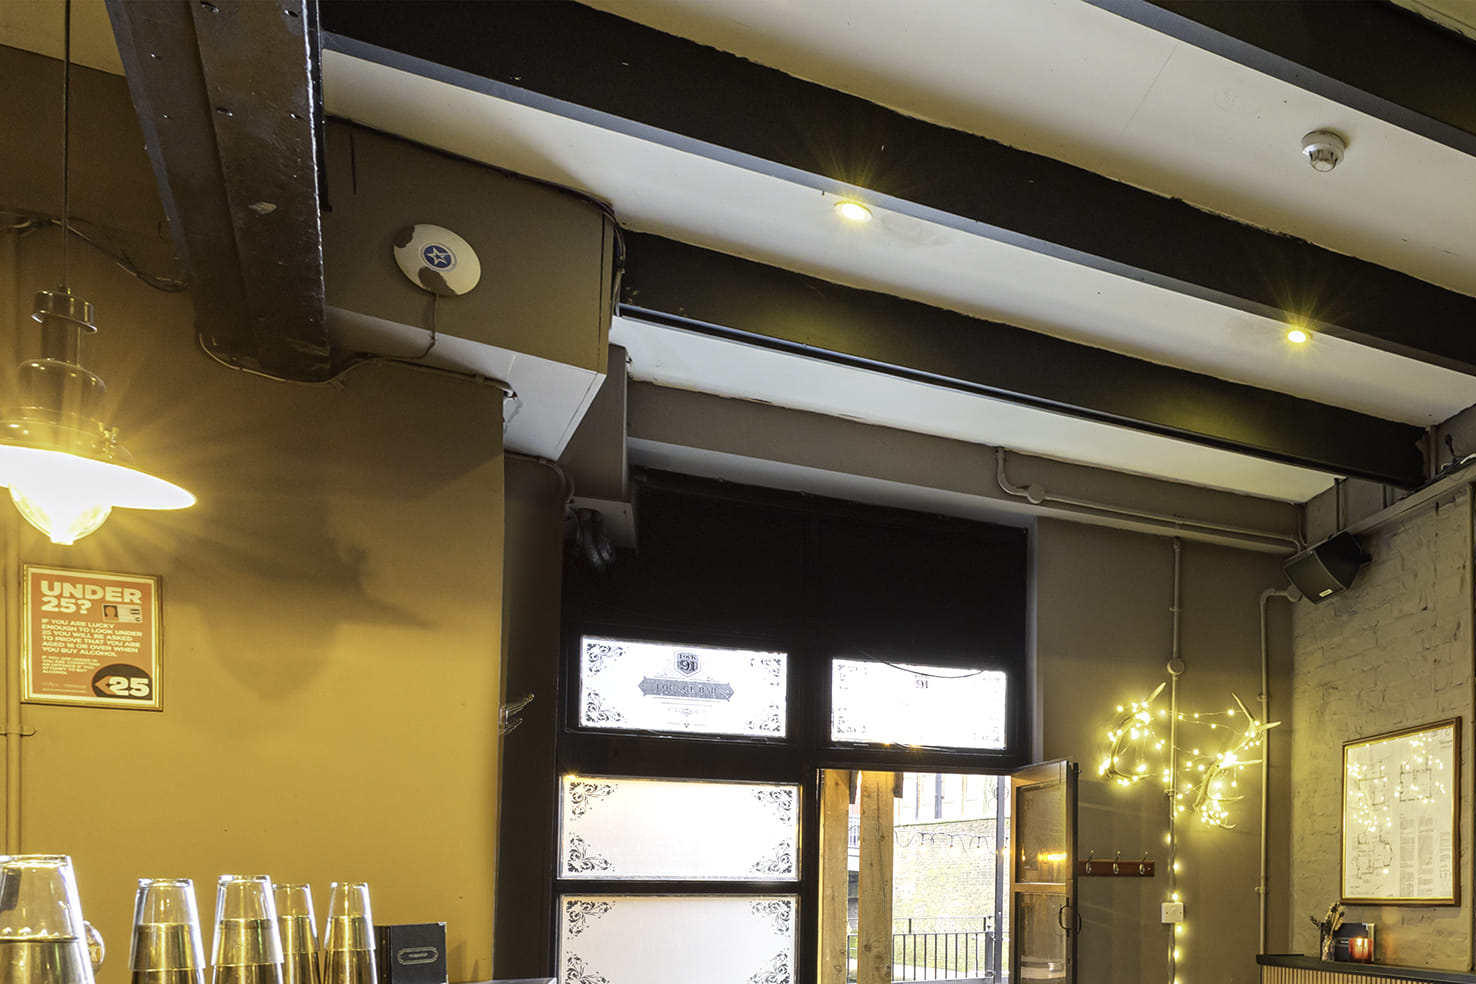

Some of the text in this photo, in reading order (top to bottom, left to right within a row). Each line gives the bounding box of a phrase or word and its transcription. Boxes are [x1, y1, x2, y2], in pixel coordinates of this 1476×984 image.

[40, 580, 143, 604] UNDER
[40, 596, 92, 614] 25?
[88, 621, 115, 629] LUCKY
[114, 629, 142, 637] UNDER
[679, 660, 697, 672] 91
